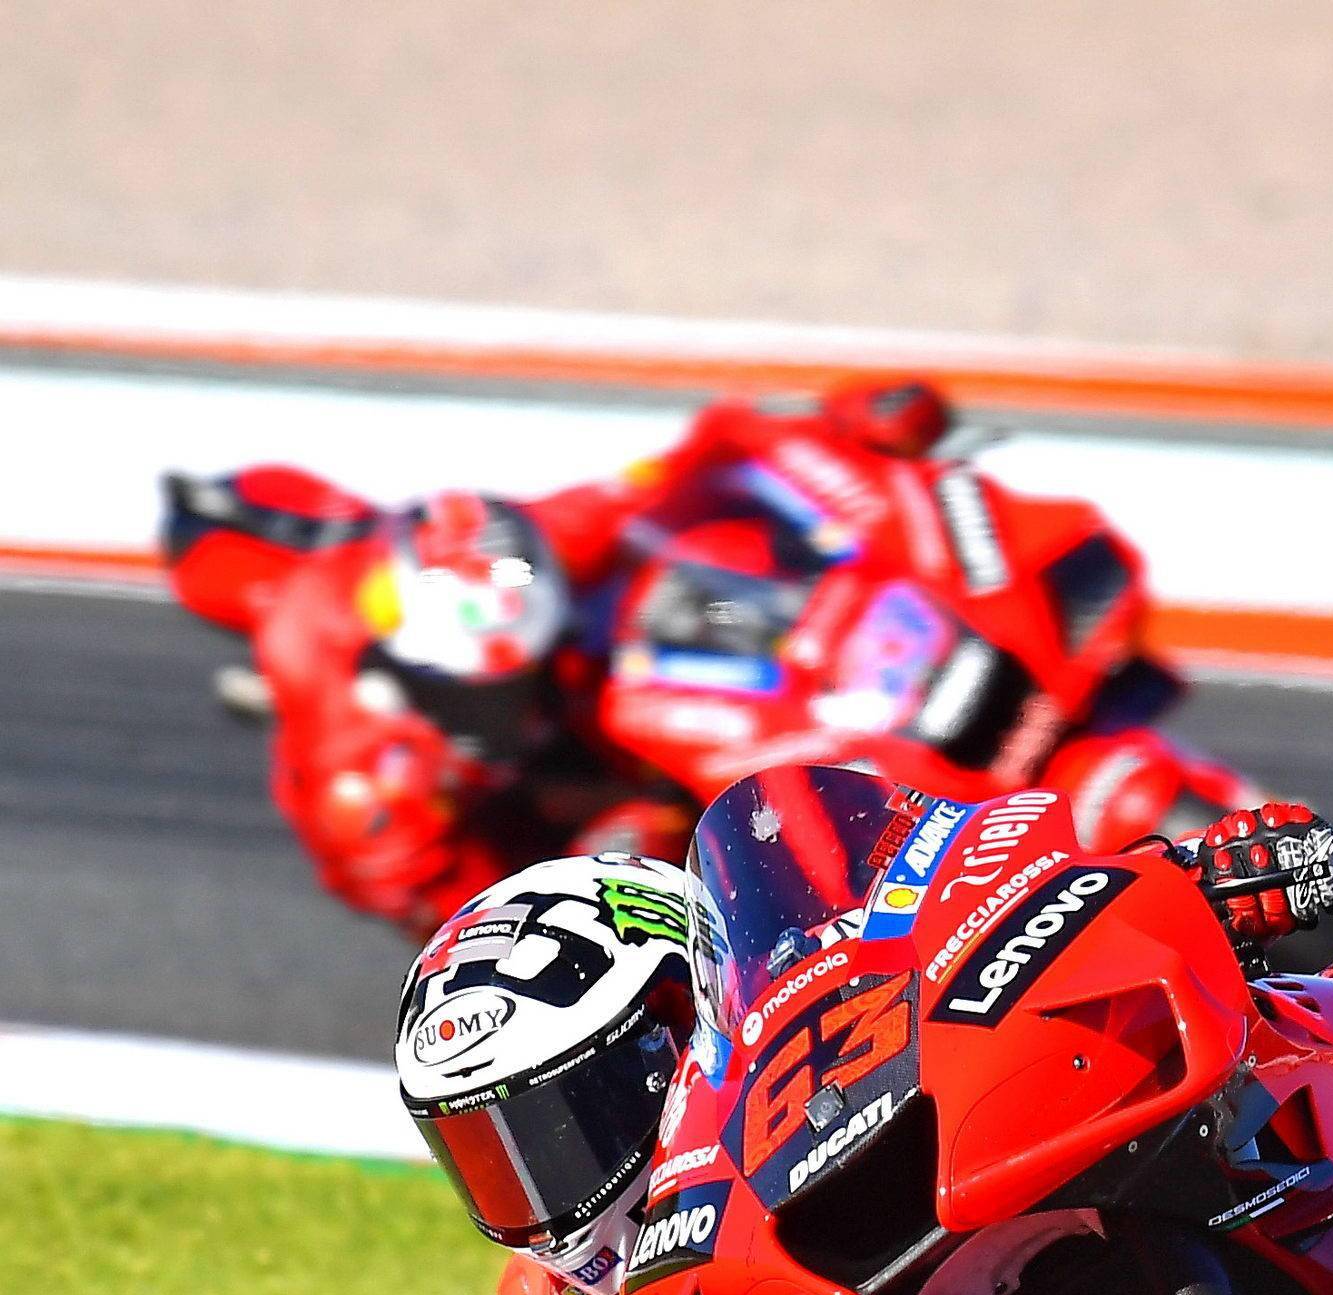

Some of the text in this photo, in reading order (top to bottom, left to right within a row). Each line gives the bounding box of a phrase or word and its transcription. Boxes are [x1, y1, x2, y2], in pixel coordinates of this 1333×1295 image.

[457, 923, 513, 940] Lenovo
[925, 850, 1070, 983] FRECCIAROSSA
[948, 872, 1109, 1014] Lenovo
[763, 951, 848, 1019] motorola
[416, 1009, 503, 1050] SUOMY
[743, 970, 911, 1178] 63
[787, 1091, 896, 1194] DUCATI
[1208, 1166, 1311, 1228] DESMOSEDICI
[628, 1204, 716, 1271] Lenovo
